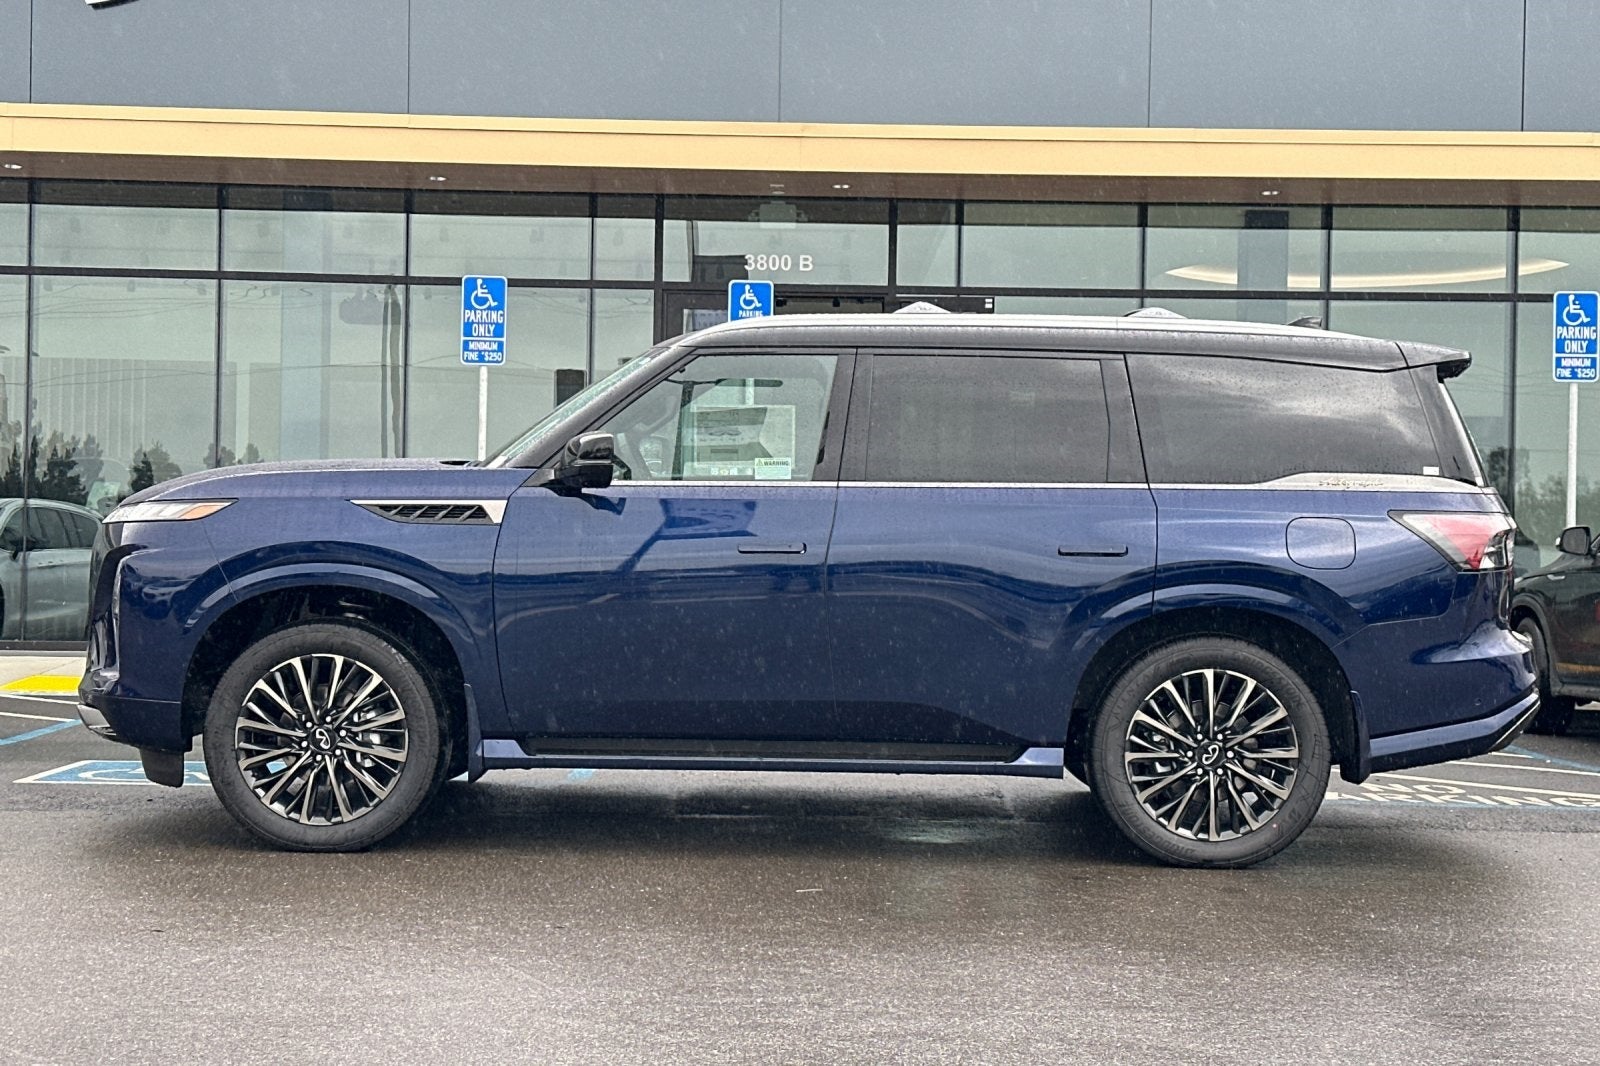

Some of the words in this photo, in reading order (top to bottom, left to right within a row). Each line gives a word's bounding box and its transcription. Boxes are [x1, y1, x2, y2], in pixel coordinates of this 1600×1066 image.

[744, 254, 791, 271] 3800
[799, 254, 814, 271] B
[464, 309, 504, 323] PARKING
[472, 323, 496, 337] ONLY
[1556, 326, 1597, 340] PARKING
[468, 341, 498, 352] MINIMUM
[1564, 340, 1588, 353] ONLY
[463, 351, 479, 361] FINE
[1561, 358, 1591, 368] MINIMUM
[1556, 368, 1572, 378] FINE
[1360, 782, 1467, 794] NO
[1325, 792, 1600, 807] ARKING
